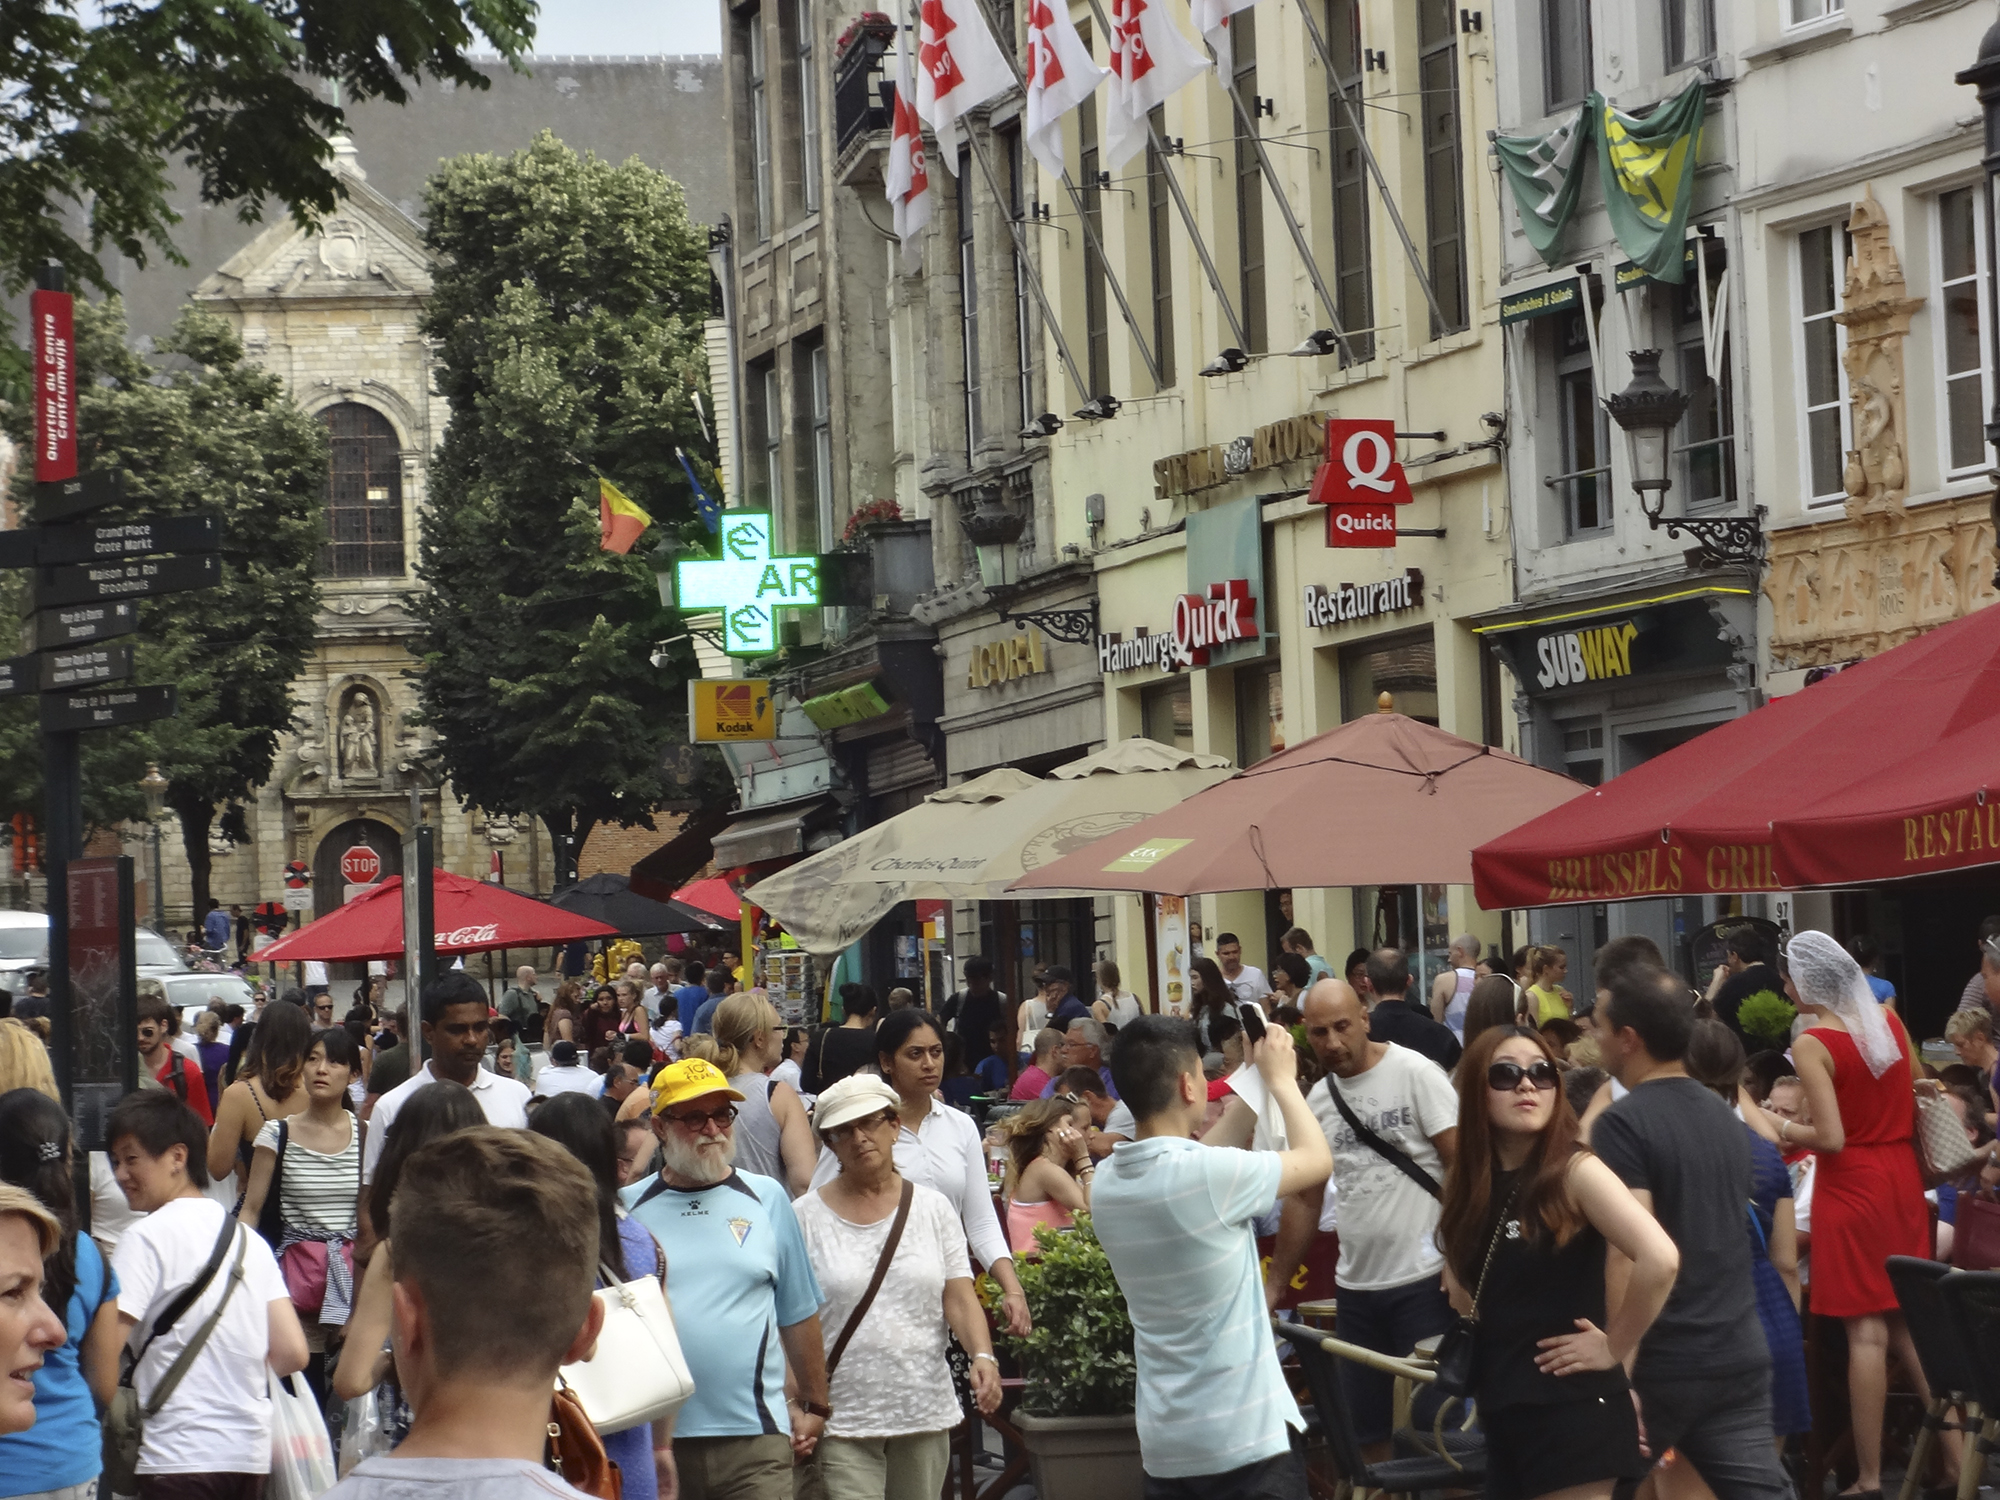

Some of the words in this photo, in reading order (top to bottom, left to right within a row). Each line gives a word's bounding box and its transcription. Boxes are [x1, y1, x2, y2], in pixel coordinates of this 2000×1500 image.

[44, 314, 56, 365] Centre
[45, 373, 56, 391] du
[56, 338, 68, 439] Centrumwijk
[46, 398, 58, 461] Quartier
[1343, 430, 1395, 493] Q
[1335, 513, 1393, 533] Quick
[94, 542, 121, 553] Grote
[124, 539, 152, 550] Markt
[89, 568, 122, 581] Maison
[126, 566, 138, 577] du
[142, 564, 158, 575] Roi
[99, 580, 149, 594] Broodhuis
[1304, 568, 1414, 627] Restaurant
[1098, 625, 1176, 673] Hamburge
[1173, 579, 1246, 666] Quick
[968, 629, 1046, 689] AGORA
[1537, 620, 1638, 690] SUBWAY
[716, 722, 754, 733] Kodak
[343, 858, 378, 873] STOP
[871, 856, 938, 871] Charles
[1547, 847, 1682, 899] BRUSSELS
[1776, 901, 1788, 918] 97
